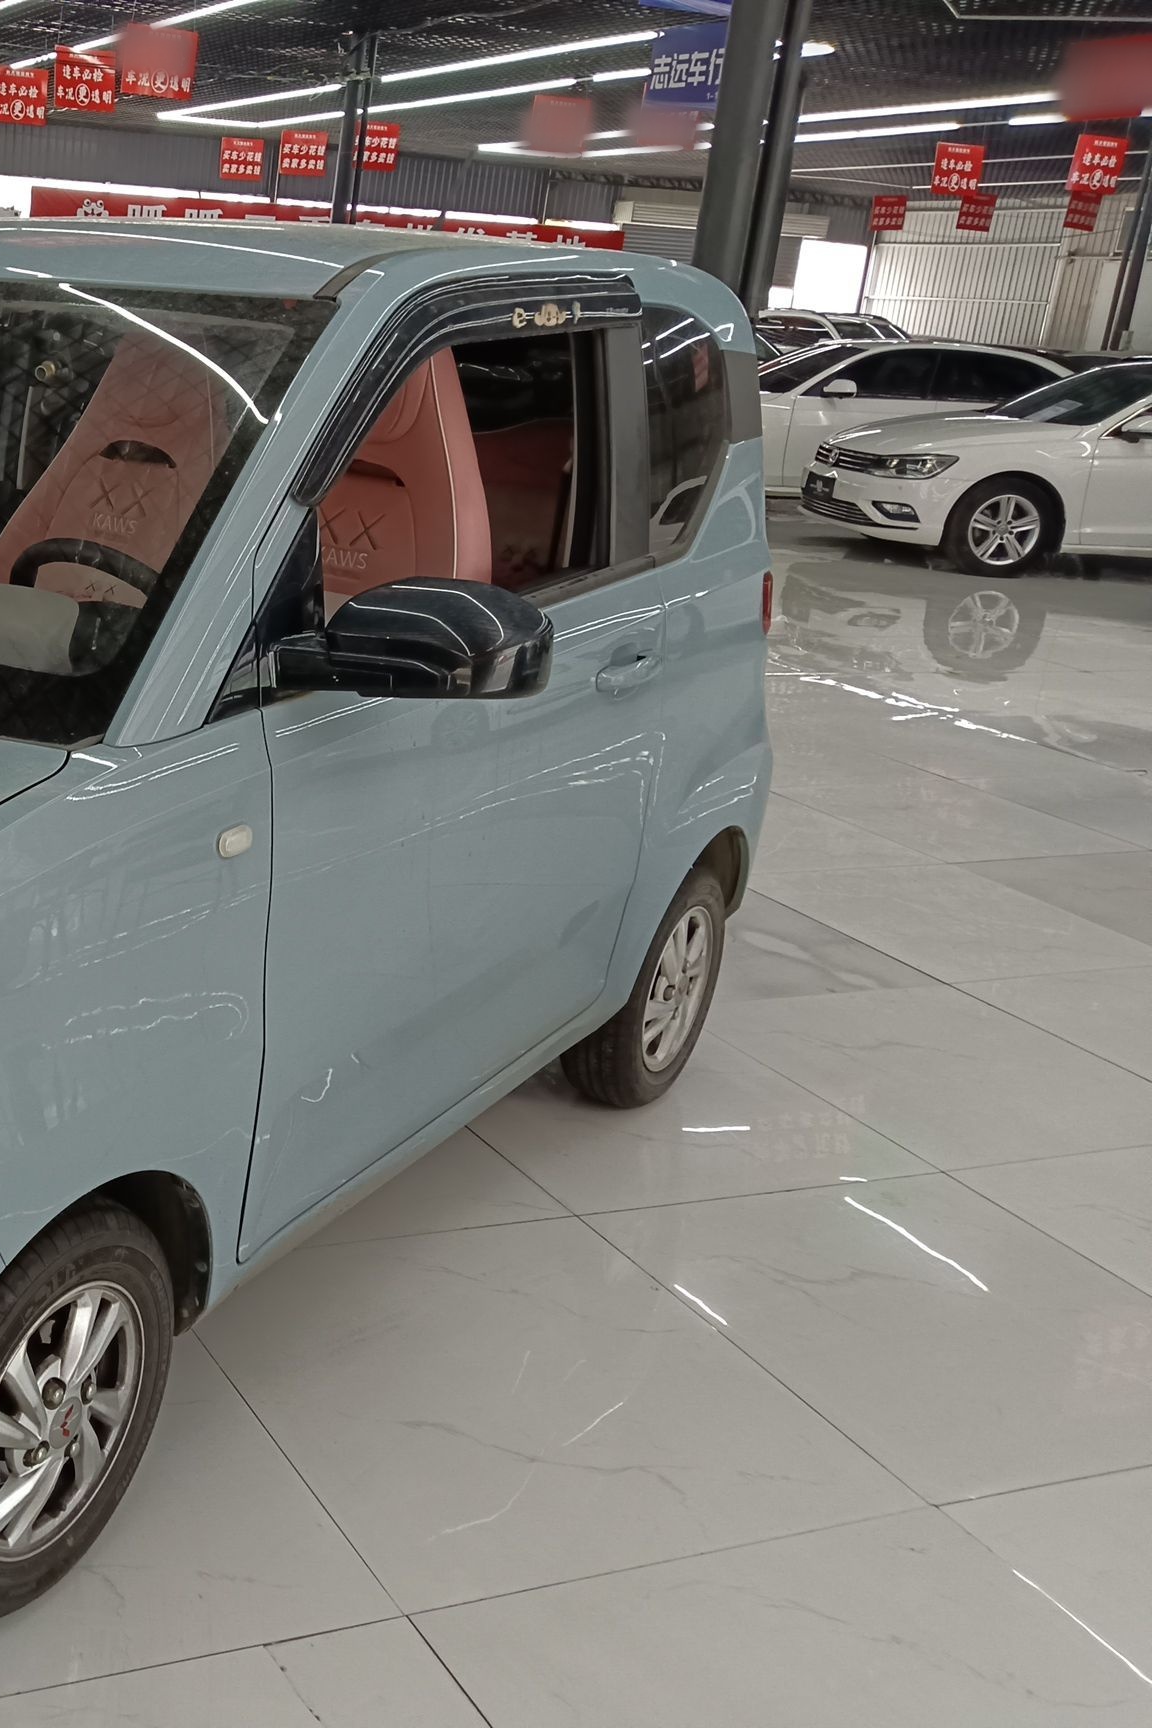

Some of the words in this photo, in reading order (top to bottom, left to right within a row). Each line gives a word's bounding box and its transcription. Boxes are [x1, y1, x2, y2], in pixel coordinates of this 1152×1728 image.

[650, 48, 724, 90] 志远车行
[57, 83, 112, 106] 车况更透明
[223, 150, 262, 162] 买车少花钱
[282, 143, 325, 156] 买车少花钱
[222, 163, 261, 175] 卖家多卖钱
[282, 158, 324, 170] 卖家多卖钱
[91, 511, 138, 535] KAWS
